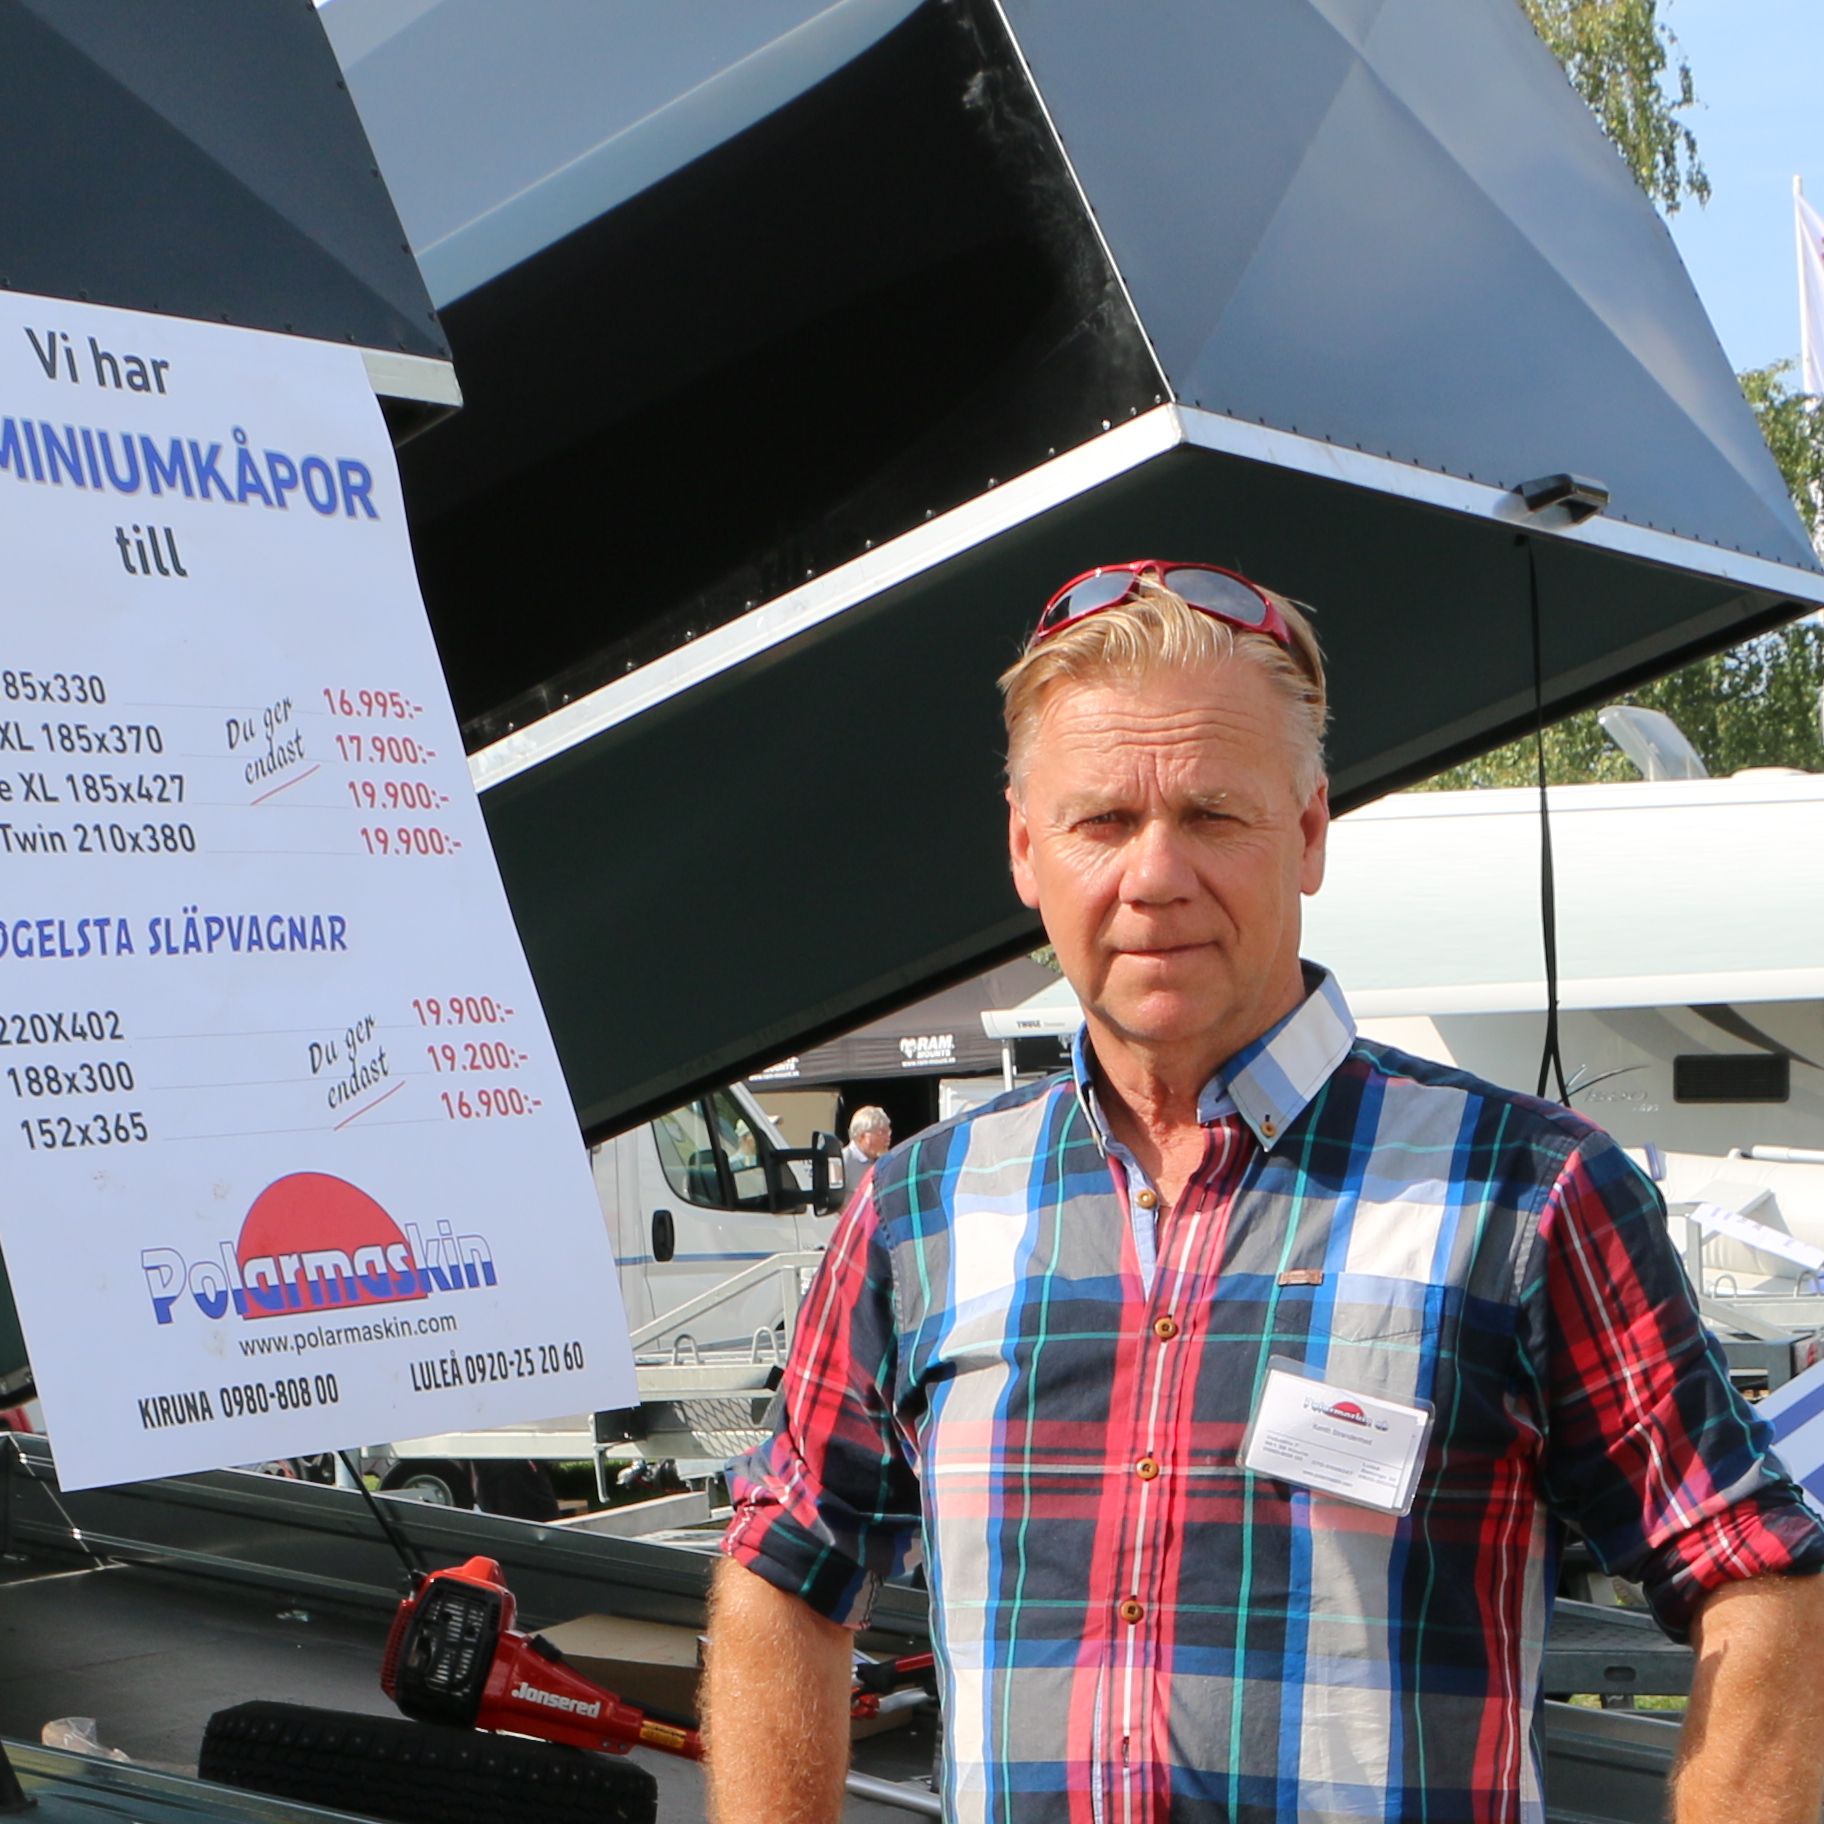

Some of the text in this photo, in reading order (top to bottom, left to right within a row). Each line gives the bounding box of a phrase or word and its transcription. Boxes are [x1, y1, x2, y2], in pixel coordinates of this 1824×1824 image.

[24, 326, 170, 396] Vi har
[116, 526, 189, 578] till
[225, 694, 296, 751] Du ger
[323, 687, 425, 721] 16.995:-
[41, 722, 163, 755] 185x370
[335, 734, 438, 766] 17.900:-
[243, 733, 307, 788] endast
[21, 771, 59, 803] XL
[64, 772, 187, 805] 185x427
[347, 779, 450, 812] 19.900:-
[73, 822, 197, 856] 210x380
[360, 827, 463, 858] 19.900:-
[148, 906, 348, 956] SLÄPVAGNAR
[412, 995, 515, 1028] 19.900:-
[307, 1013, 378, 1076] Du ger
[917, 1033, 954, 1051] RAM
[6, 1041, 529, 1099] 188x300 19.200:-
[326, 1048, 390, 1112] endast
[20, 1087, 543, 1151] 152x365 16.900:-
[140, 1218, 499, 1327] Polarmaskin
[238, 1309, 458, 1359] www.polarmaskin.com
[409, 1341, 585, 1394] LULEÅ 0920-25 20 60
[137, 1373, 340, 1430] KIRUNA 0980-808 00
[512, 1681, 601, 1719] Jonsered
